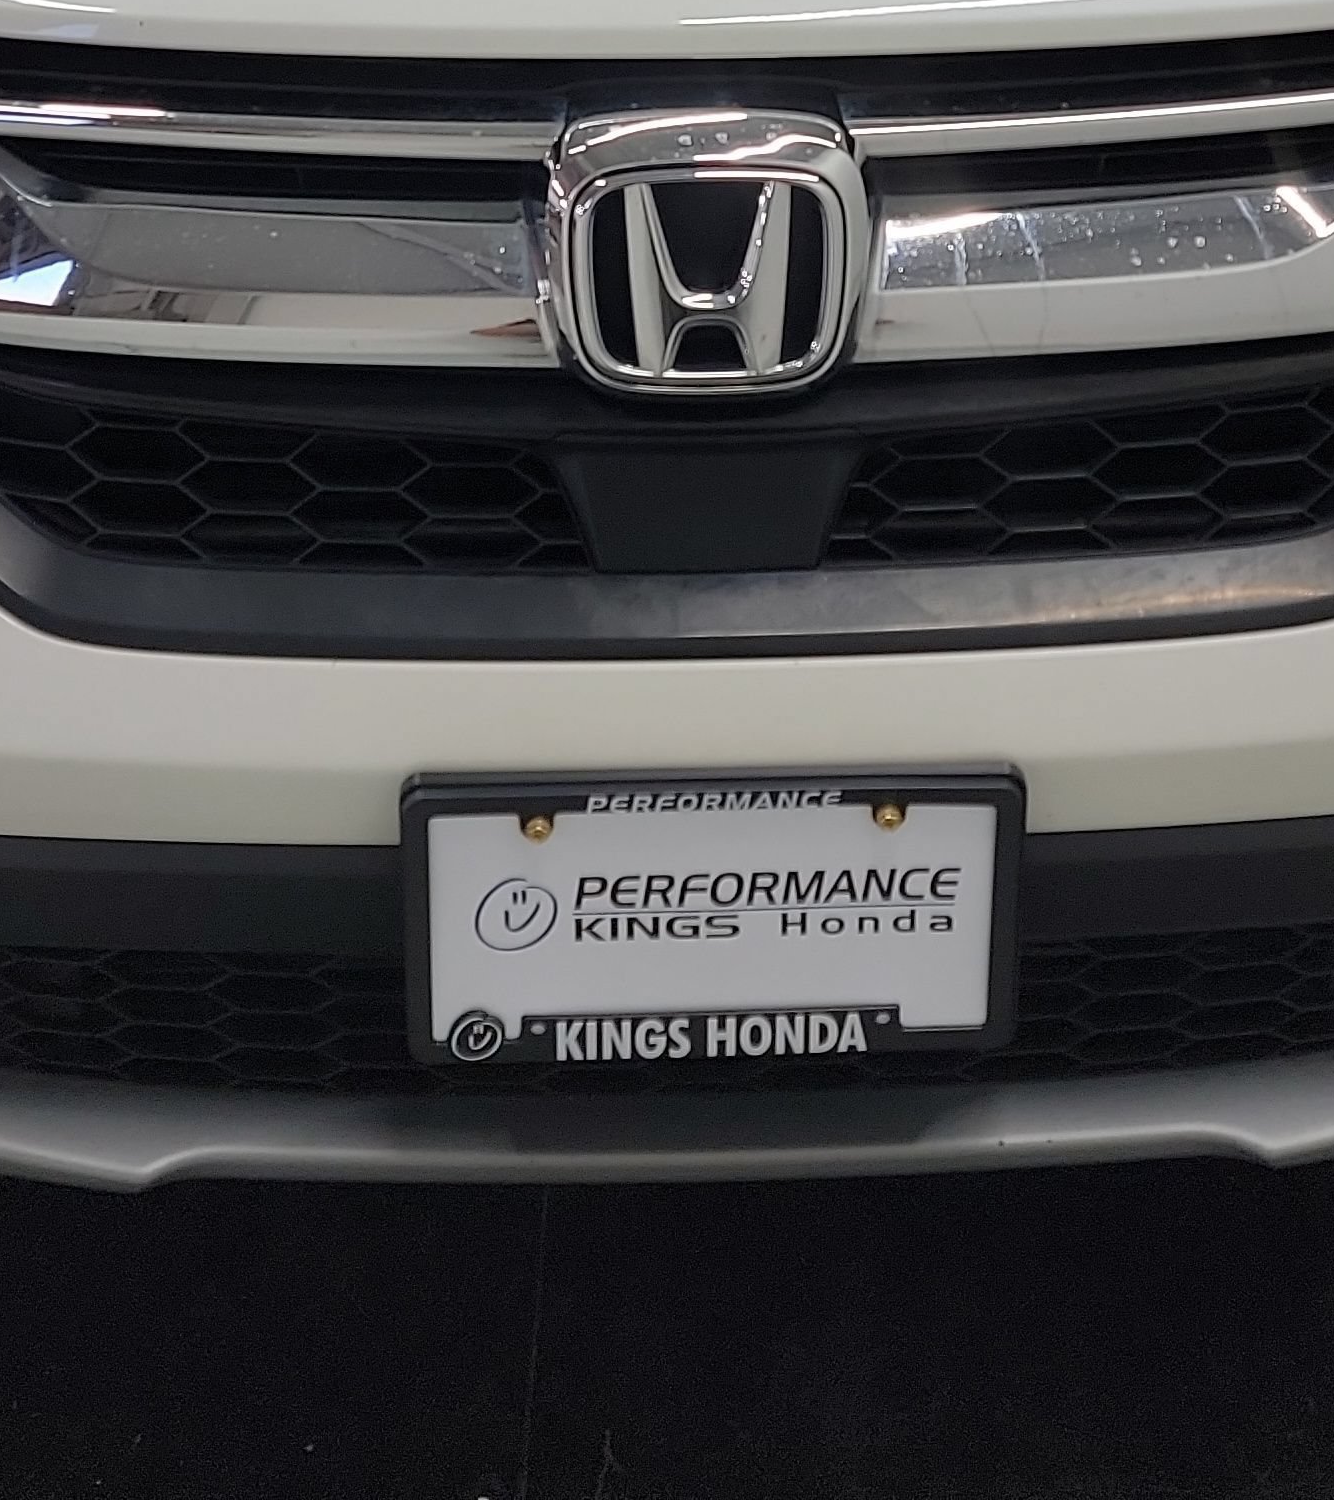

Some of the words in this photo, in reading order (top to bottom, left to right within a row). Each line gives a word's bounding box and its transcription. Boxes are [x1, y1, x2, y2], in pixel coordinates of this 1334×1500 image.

[586, 790, 842, 814] PERFORMANCE
[573, 867, 961, 910] PERFORMANCE
[574, 915, 740, 942] KINGS
[780, 909, 954, 936] Honda
[555, 1017, 691, 1061] KINGS
[706, 1012, 867, 1057] HONDA
